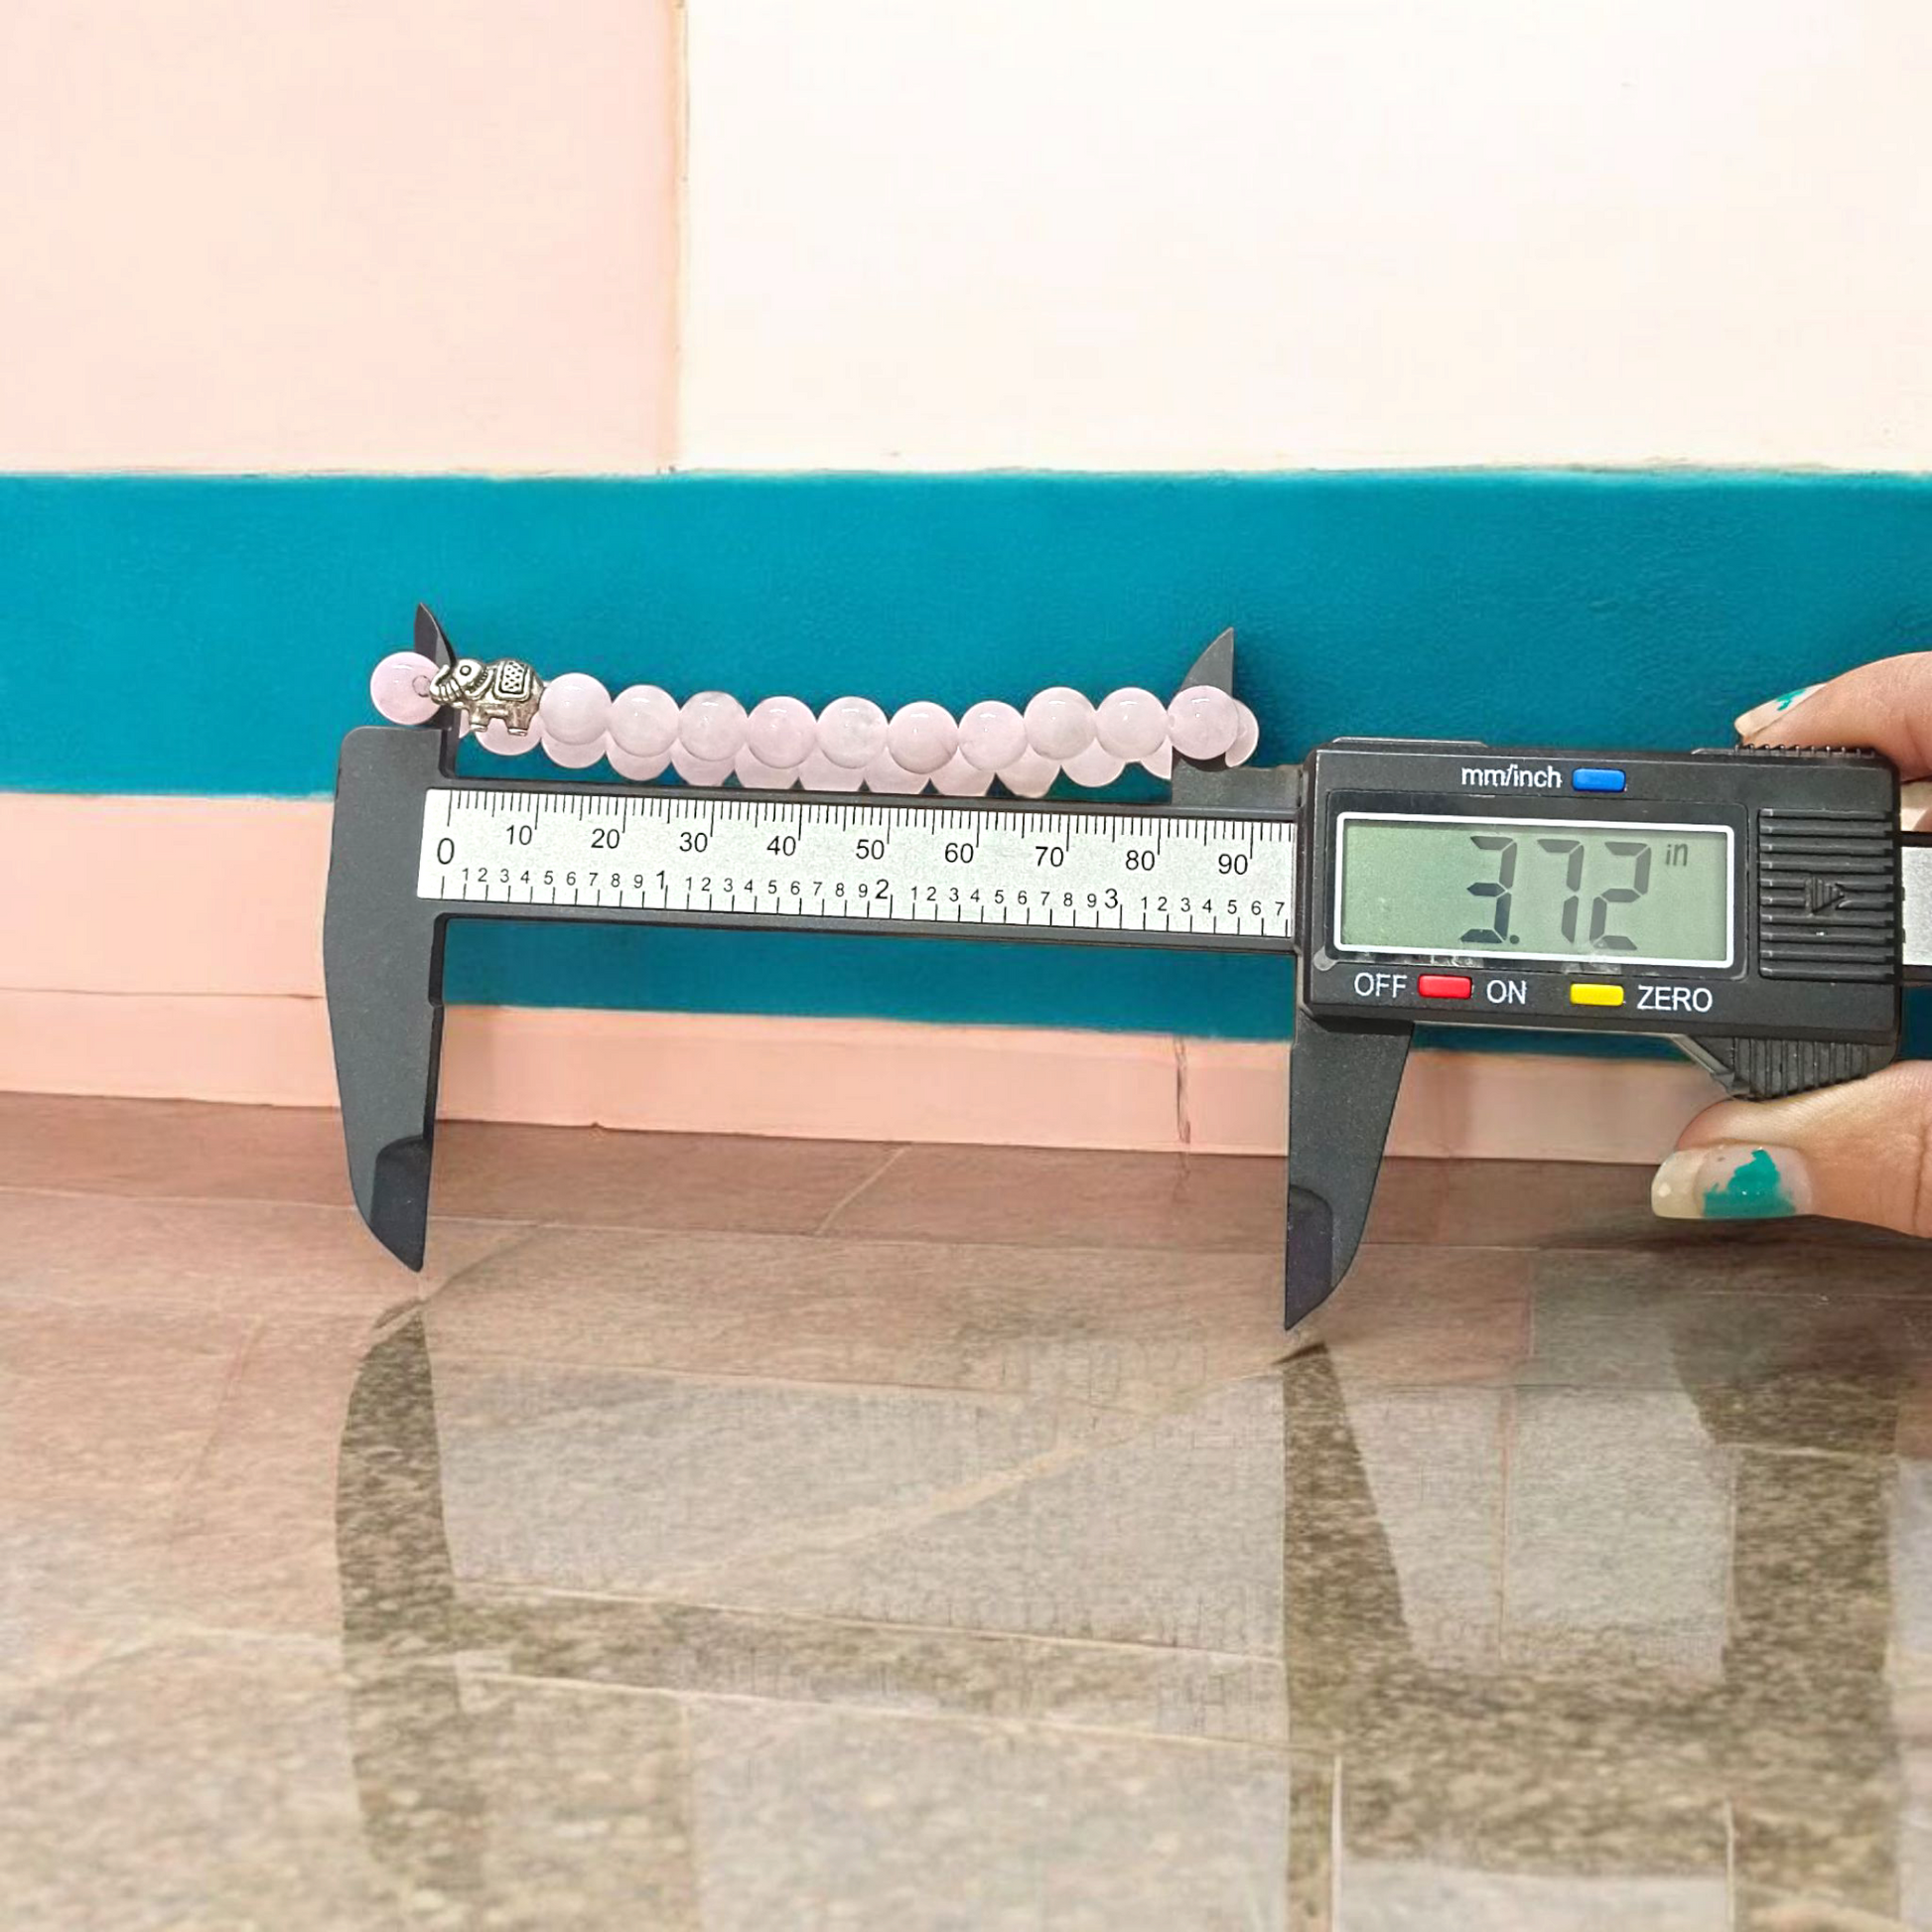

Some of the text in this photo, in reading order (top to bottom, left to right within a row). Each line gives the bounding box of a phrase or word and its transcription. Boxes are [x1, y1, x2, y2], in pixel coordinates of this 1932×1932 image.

[1460, 763, 1564, 789] mm/inch
[437, 824, 1249, 876] 0 10 20 30 40 50 60 70 80 90
[462, 868, 1285, 916] 1 2 3 4 5 6 7 8 9 1 1 2 3 4 5 6 7 8 9 2 1 2 3 4 5 6 7 8 9 3 1 2 3 4 5 6 7
[1458, 835, 1689, 952] 3.72 in
[1353, 972, 1409, 999] OFF
[1485, 979, 1528, 1005] ON
[1635, 985, 1714, 1013] ZERO
